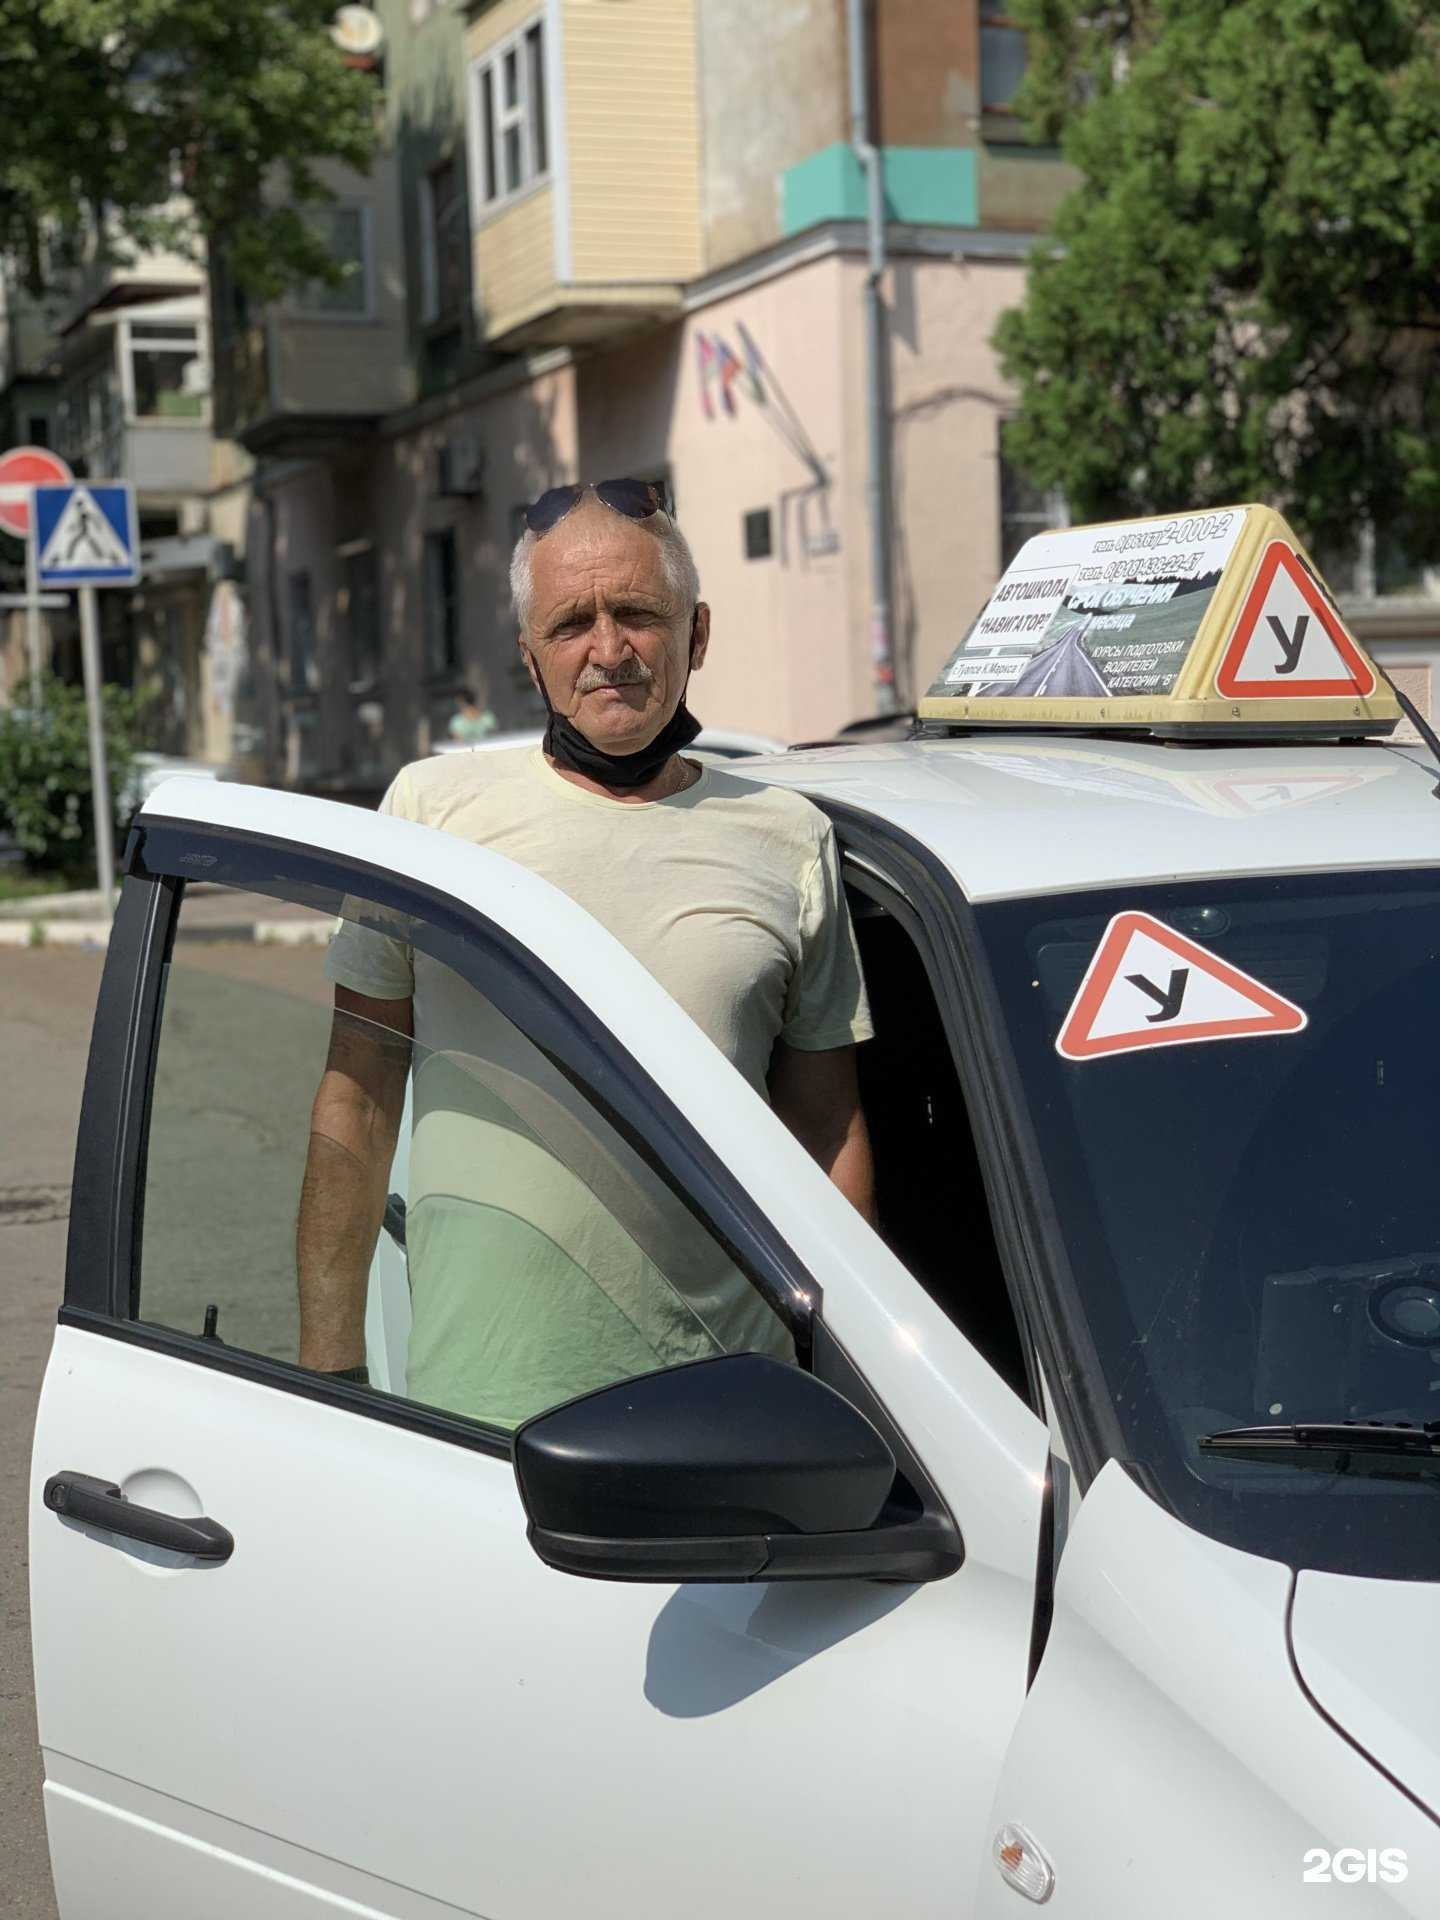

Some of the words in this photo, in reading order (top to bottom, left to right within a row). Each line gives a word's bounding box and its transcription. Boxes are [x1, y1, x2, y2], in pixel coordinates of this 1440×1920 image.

[994, 578, 1069, 602] АВТОШКОЛА
[1091, 645, 1123, 658] КУРСЫ
[1123, 640, 1185, 657] ПОДГОТОВКИ
[1265, 615, 1310, 674] У
[1103, 657, 1159, 673] ВОДИТЕЛЕЙ
[1107, 674, 1160, 688] КАТЕГОРИИ
[1123, 968, 1189, 1023] У
